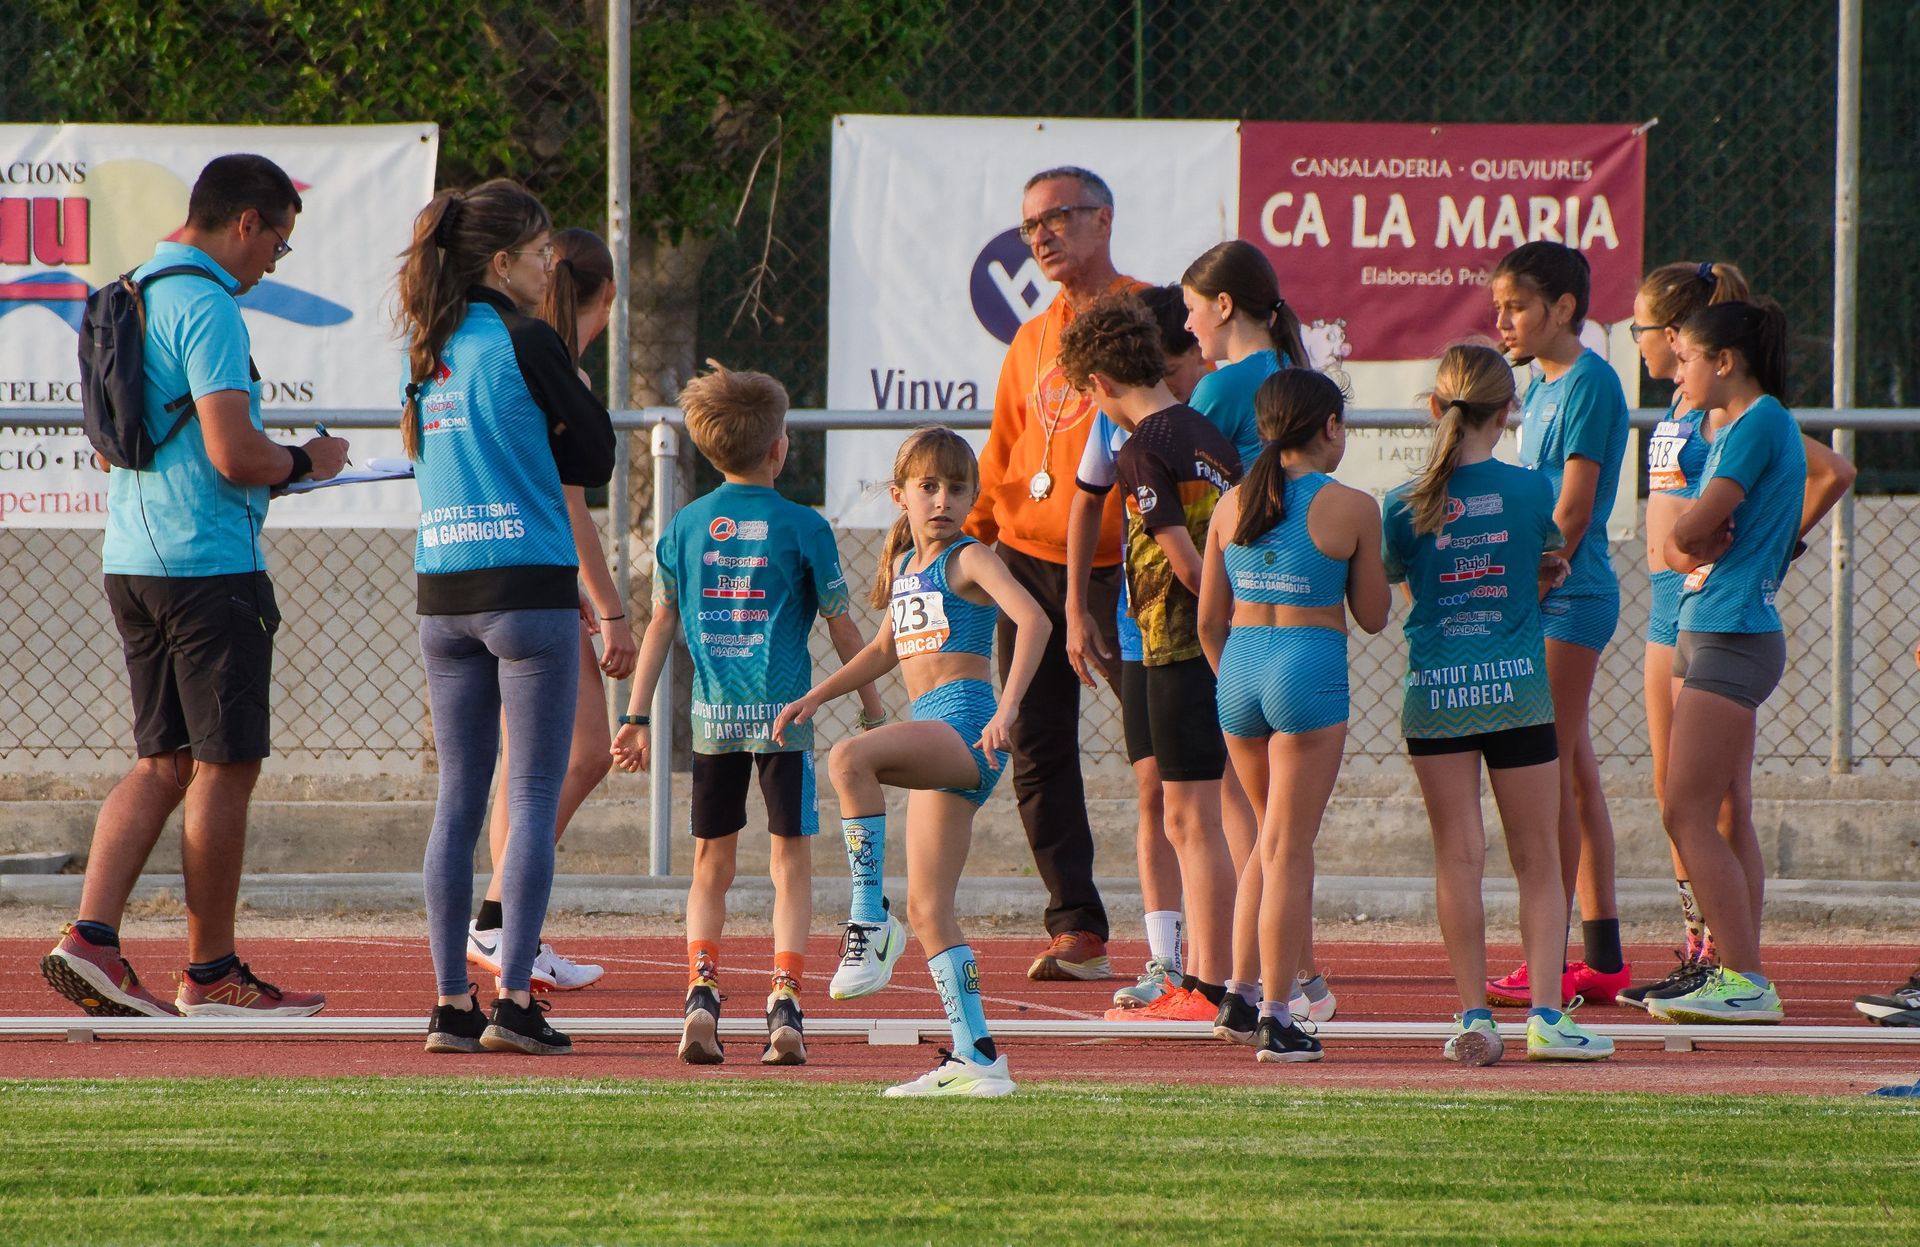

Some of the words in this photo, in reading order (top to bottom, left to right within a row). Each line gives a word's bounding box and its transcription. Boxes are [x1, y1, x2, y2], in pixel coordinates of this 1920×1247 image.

[1291, 157, 1453, 178] CANSALADERIA
[1471, 159, 1593, 182] QUEVIURES
[1261, 191, 1331, 247] CA
[1352, 193, 1416, 248] LA
[1435, 194, 1620, 250] MARIA
[1361, 266, 1453, 286] Elaboració
[0, 443, 46, 470] CIÓ
[434, 502, 520, 522] D'ATLETISME
[440, 519, 525, 545] GARRIGUES
[1451, 531, 1508, 548] esportcat
[717, 556, 768, 568] esportcat
[1455, 554, 1490, 571] Pujol
[718, 575, 750, 590] Pujol
[732, 609, 769, 621] ROMA
[1443, 624, 1490, 636] NADAL
[701, 633, 764, 646] PARQUETS
[710, 646, 753, 657] NADAL
[1473, 657, 1534, 682] ATLÈTICA
[1431, 681, 1514, 710] D'ARBECA
[736, 702, 789, 720] ATLÈTIC
[704, 721, 770, 740] D'ARBECA
